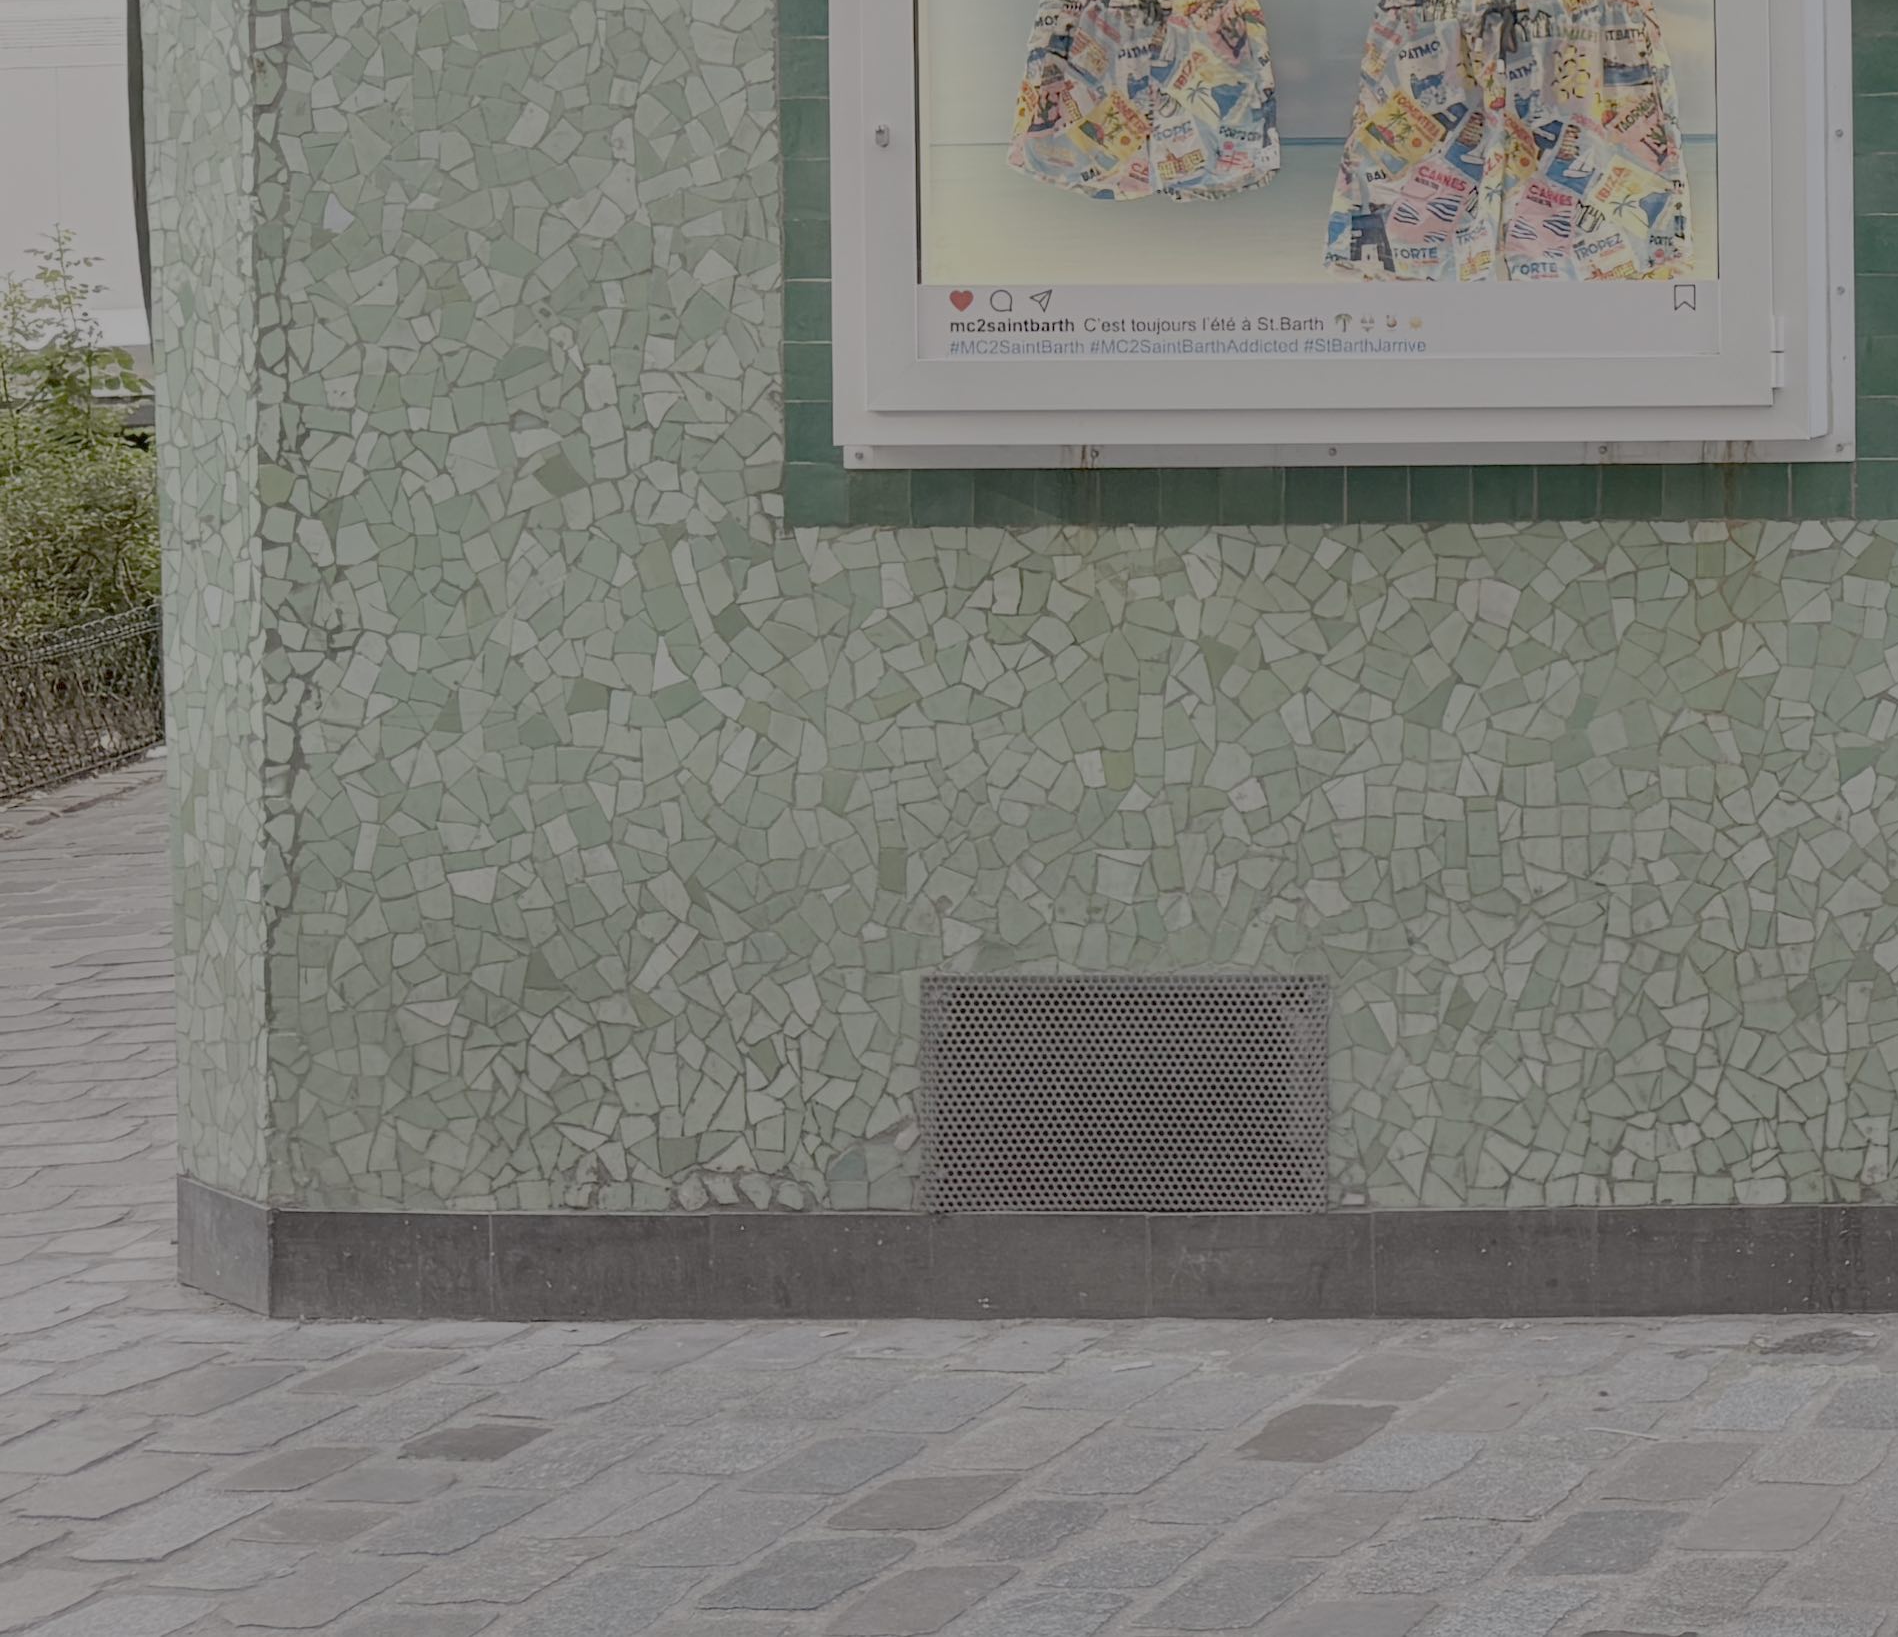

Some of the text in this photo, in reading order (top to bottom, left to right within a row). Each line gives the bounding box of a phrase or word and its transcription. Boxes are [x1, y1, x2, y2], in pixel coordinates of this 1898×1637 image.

[950, 316, 1325, 335] mc2saintbarth C'est toujours l'été à St.Barth
[950, 338, 1427, 356] #MC2SaintBarth #MC2SaintBarthAddicted #StBarthJarrive
